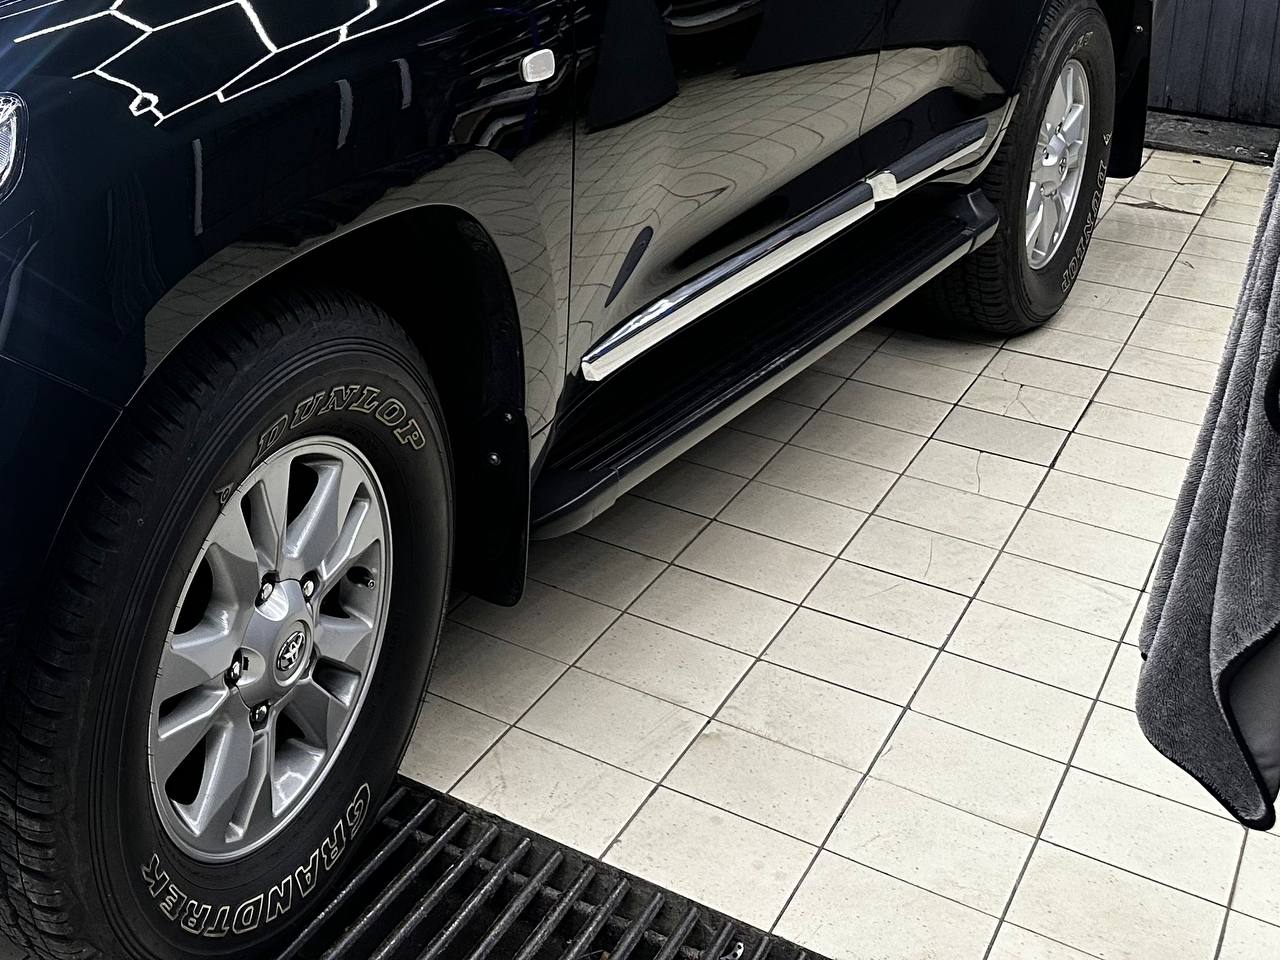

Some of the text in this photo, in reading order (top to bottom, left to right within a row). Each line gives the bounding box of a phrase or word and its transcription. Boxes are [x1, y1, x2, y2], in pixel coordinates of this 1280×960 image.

[1062, 159, 1107, 293] DUNLOP
[250, 385, 426, 468] DUNLOP
[141, 782, 371, 938] GRANDTREK
